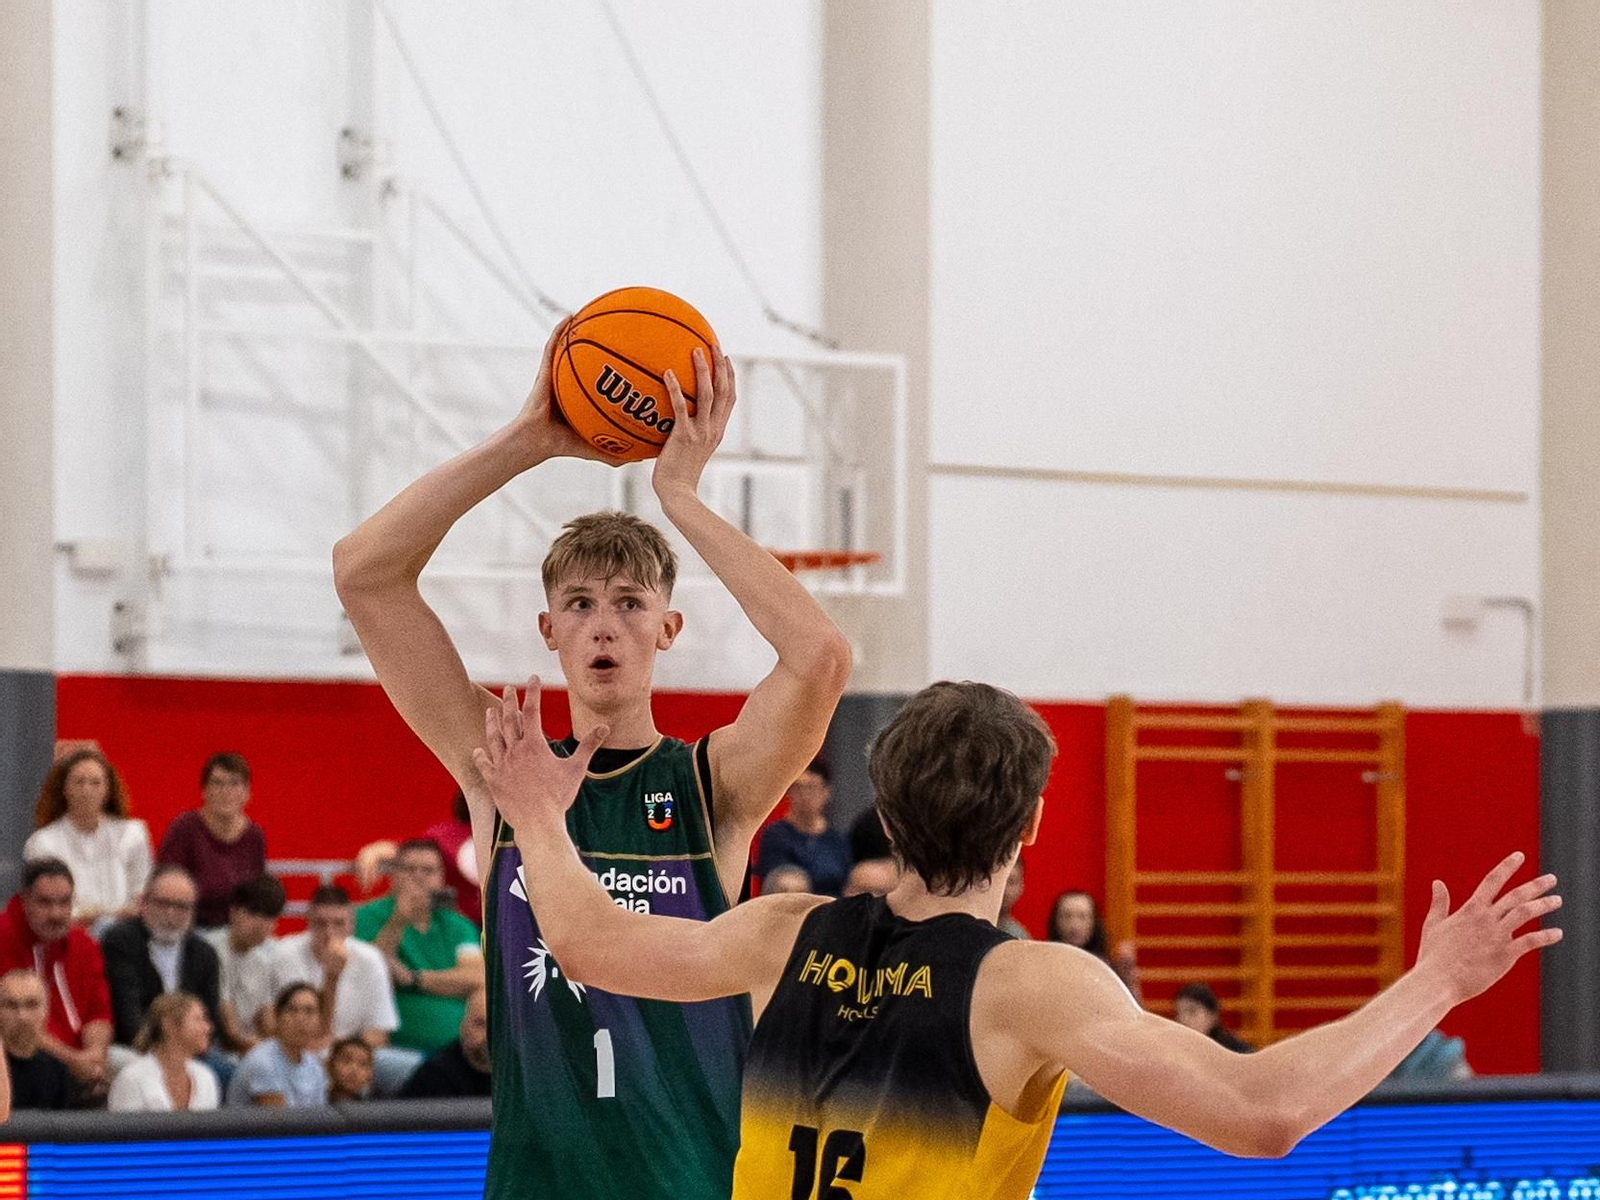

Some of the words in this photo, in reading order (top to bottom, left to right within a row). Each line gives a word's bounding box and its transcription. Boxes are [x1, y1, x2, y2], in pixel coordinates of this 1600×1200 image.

[595, 363, 675, 434] Wilso
[644, 791, 674, 804] LIGA
[591, 866, 687, 895] dación
[593, 1028, 616, 1099] 1
